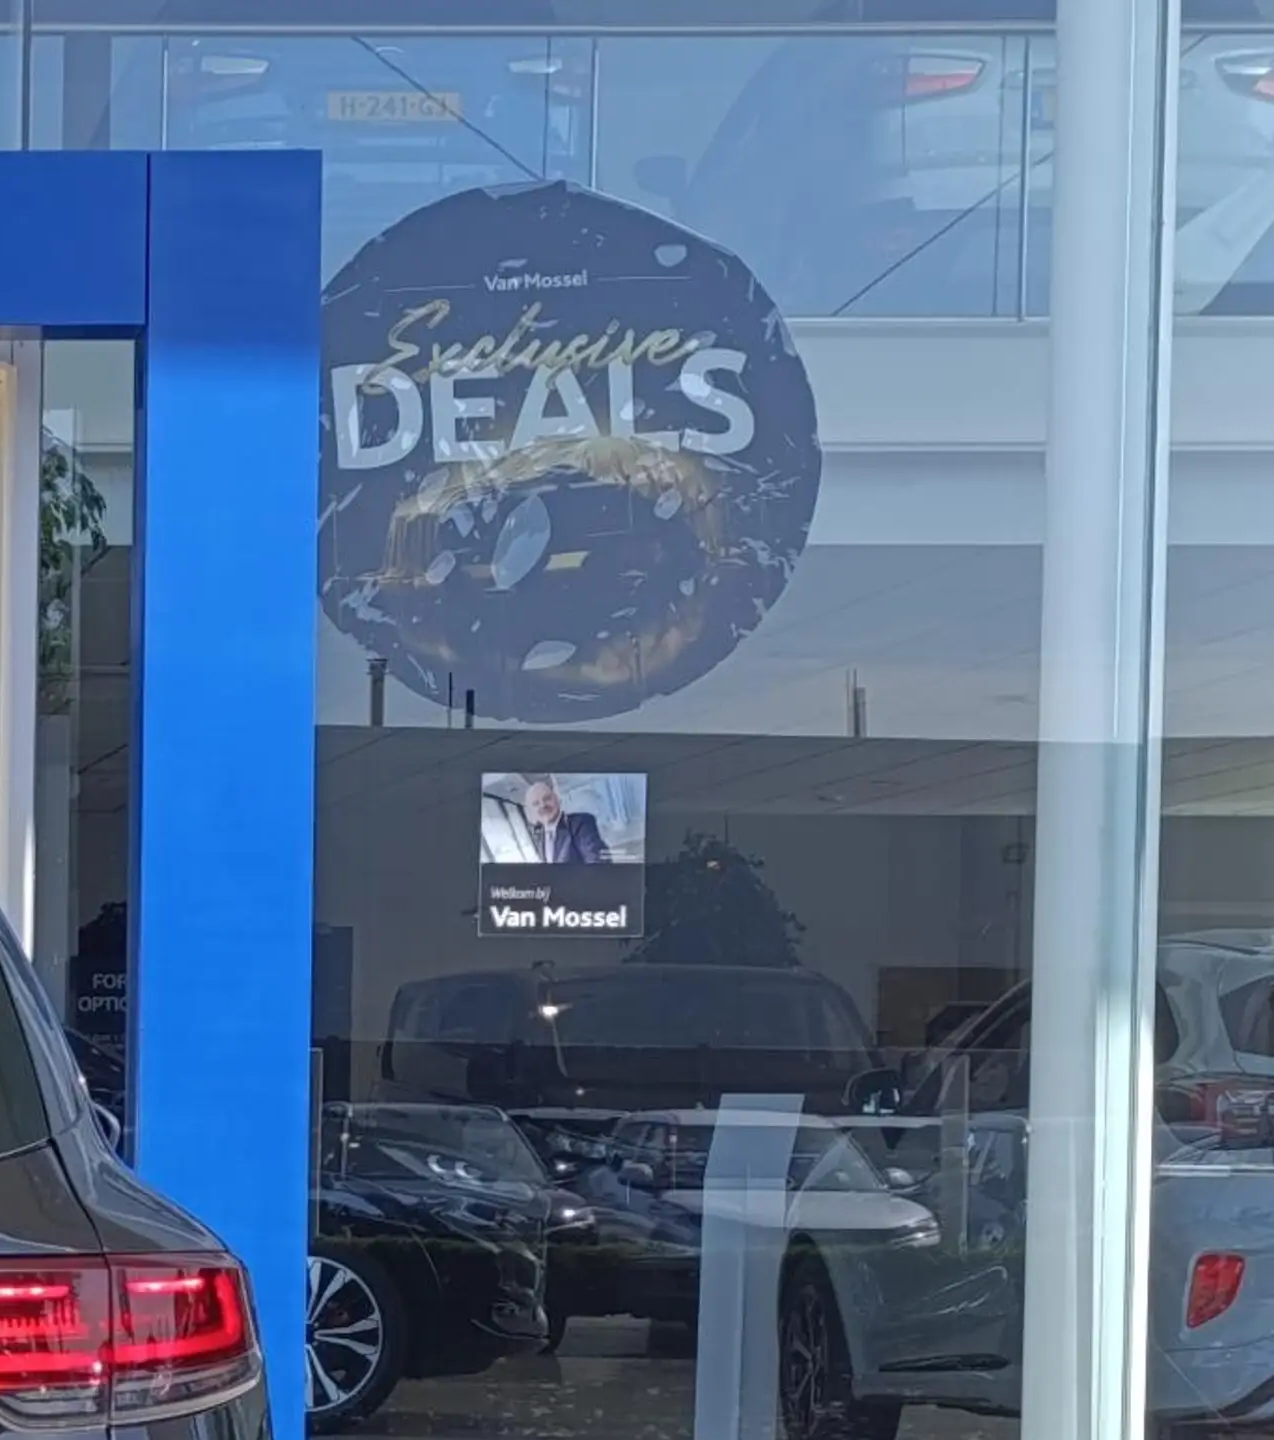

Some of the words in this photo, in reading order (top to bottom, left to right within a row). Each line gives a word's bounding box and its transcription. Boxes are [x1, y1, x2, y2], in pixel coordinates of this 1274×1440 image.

[483, 274, 519, 292] Van
[523, 269, 588, 289] Mossel
[330, 348, 755, 470] DEALS
[490, 905, 536, 928] Van
[542, 905, 627, 928] Mossel
